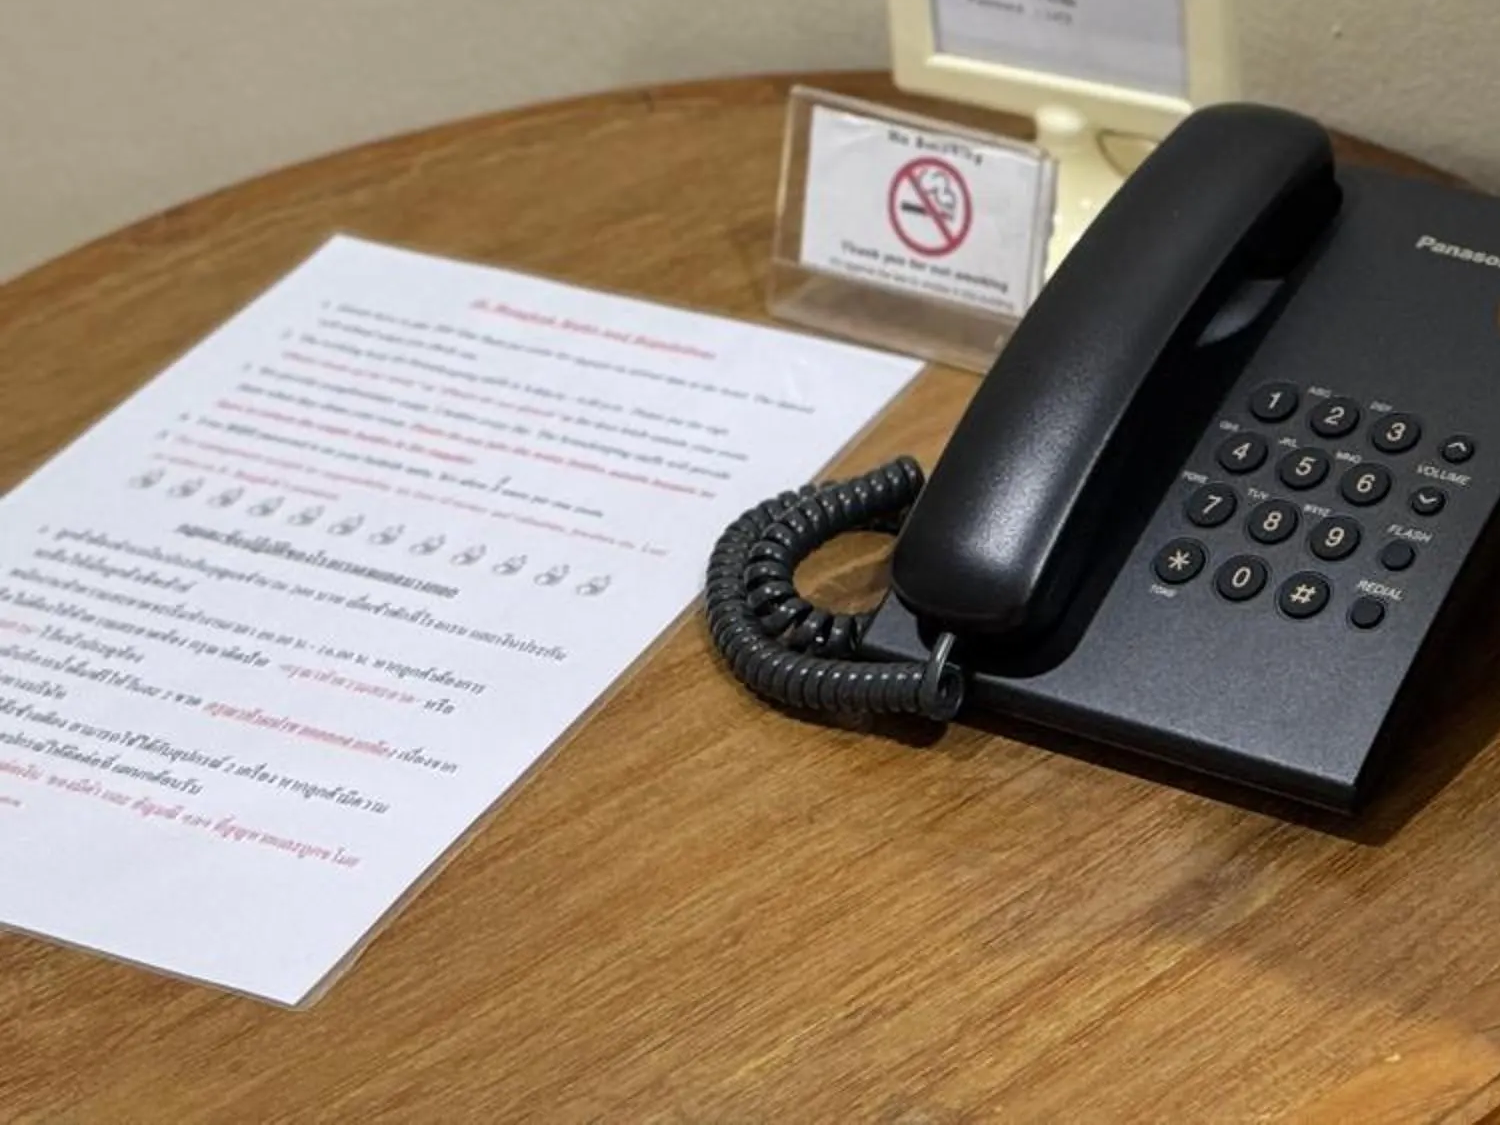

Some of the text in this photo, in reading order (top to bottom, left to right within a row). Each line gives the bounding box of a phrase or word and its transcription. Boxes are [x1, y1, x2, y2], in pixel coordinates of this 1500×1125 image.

[841, 240, 1009, 294] Thank you for not smoking
[1268, 391, 1283, 410] 1
[1323, 406, 1345, 426] 2
[1385, 422, 1407, 442] 3
[1231, 442, 1253, 461] 4
[1295, 456, 1317, 477] 5
[1416, 464, 1473, 486] VOLUME
[1356, 473, 1377, 494] 6
[1201, 493, 1224, 515] 7
[1262, 510, 1284, 532] 8
[1324, 526, 1346, 548] 9
[1387, 524, 1434, 543] FLASH
[1231, 565, 1252, 588] 0
[1289, 583, 1318, 604] #
[1356, 578, 1404, 601] REDIAL
